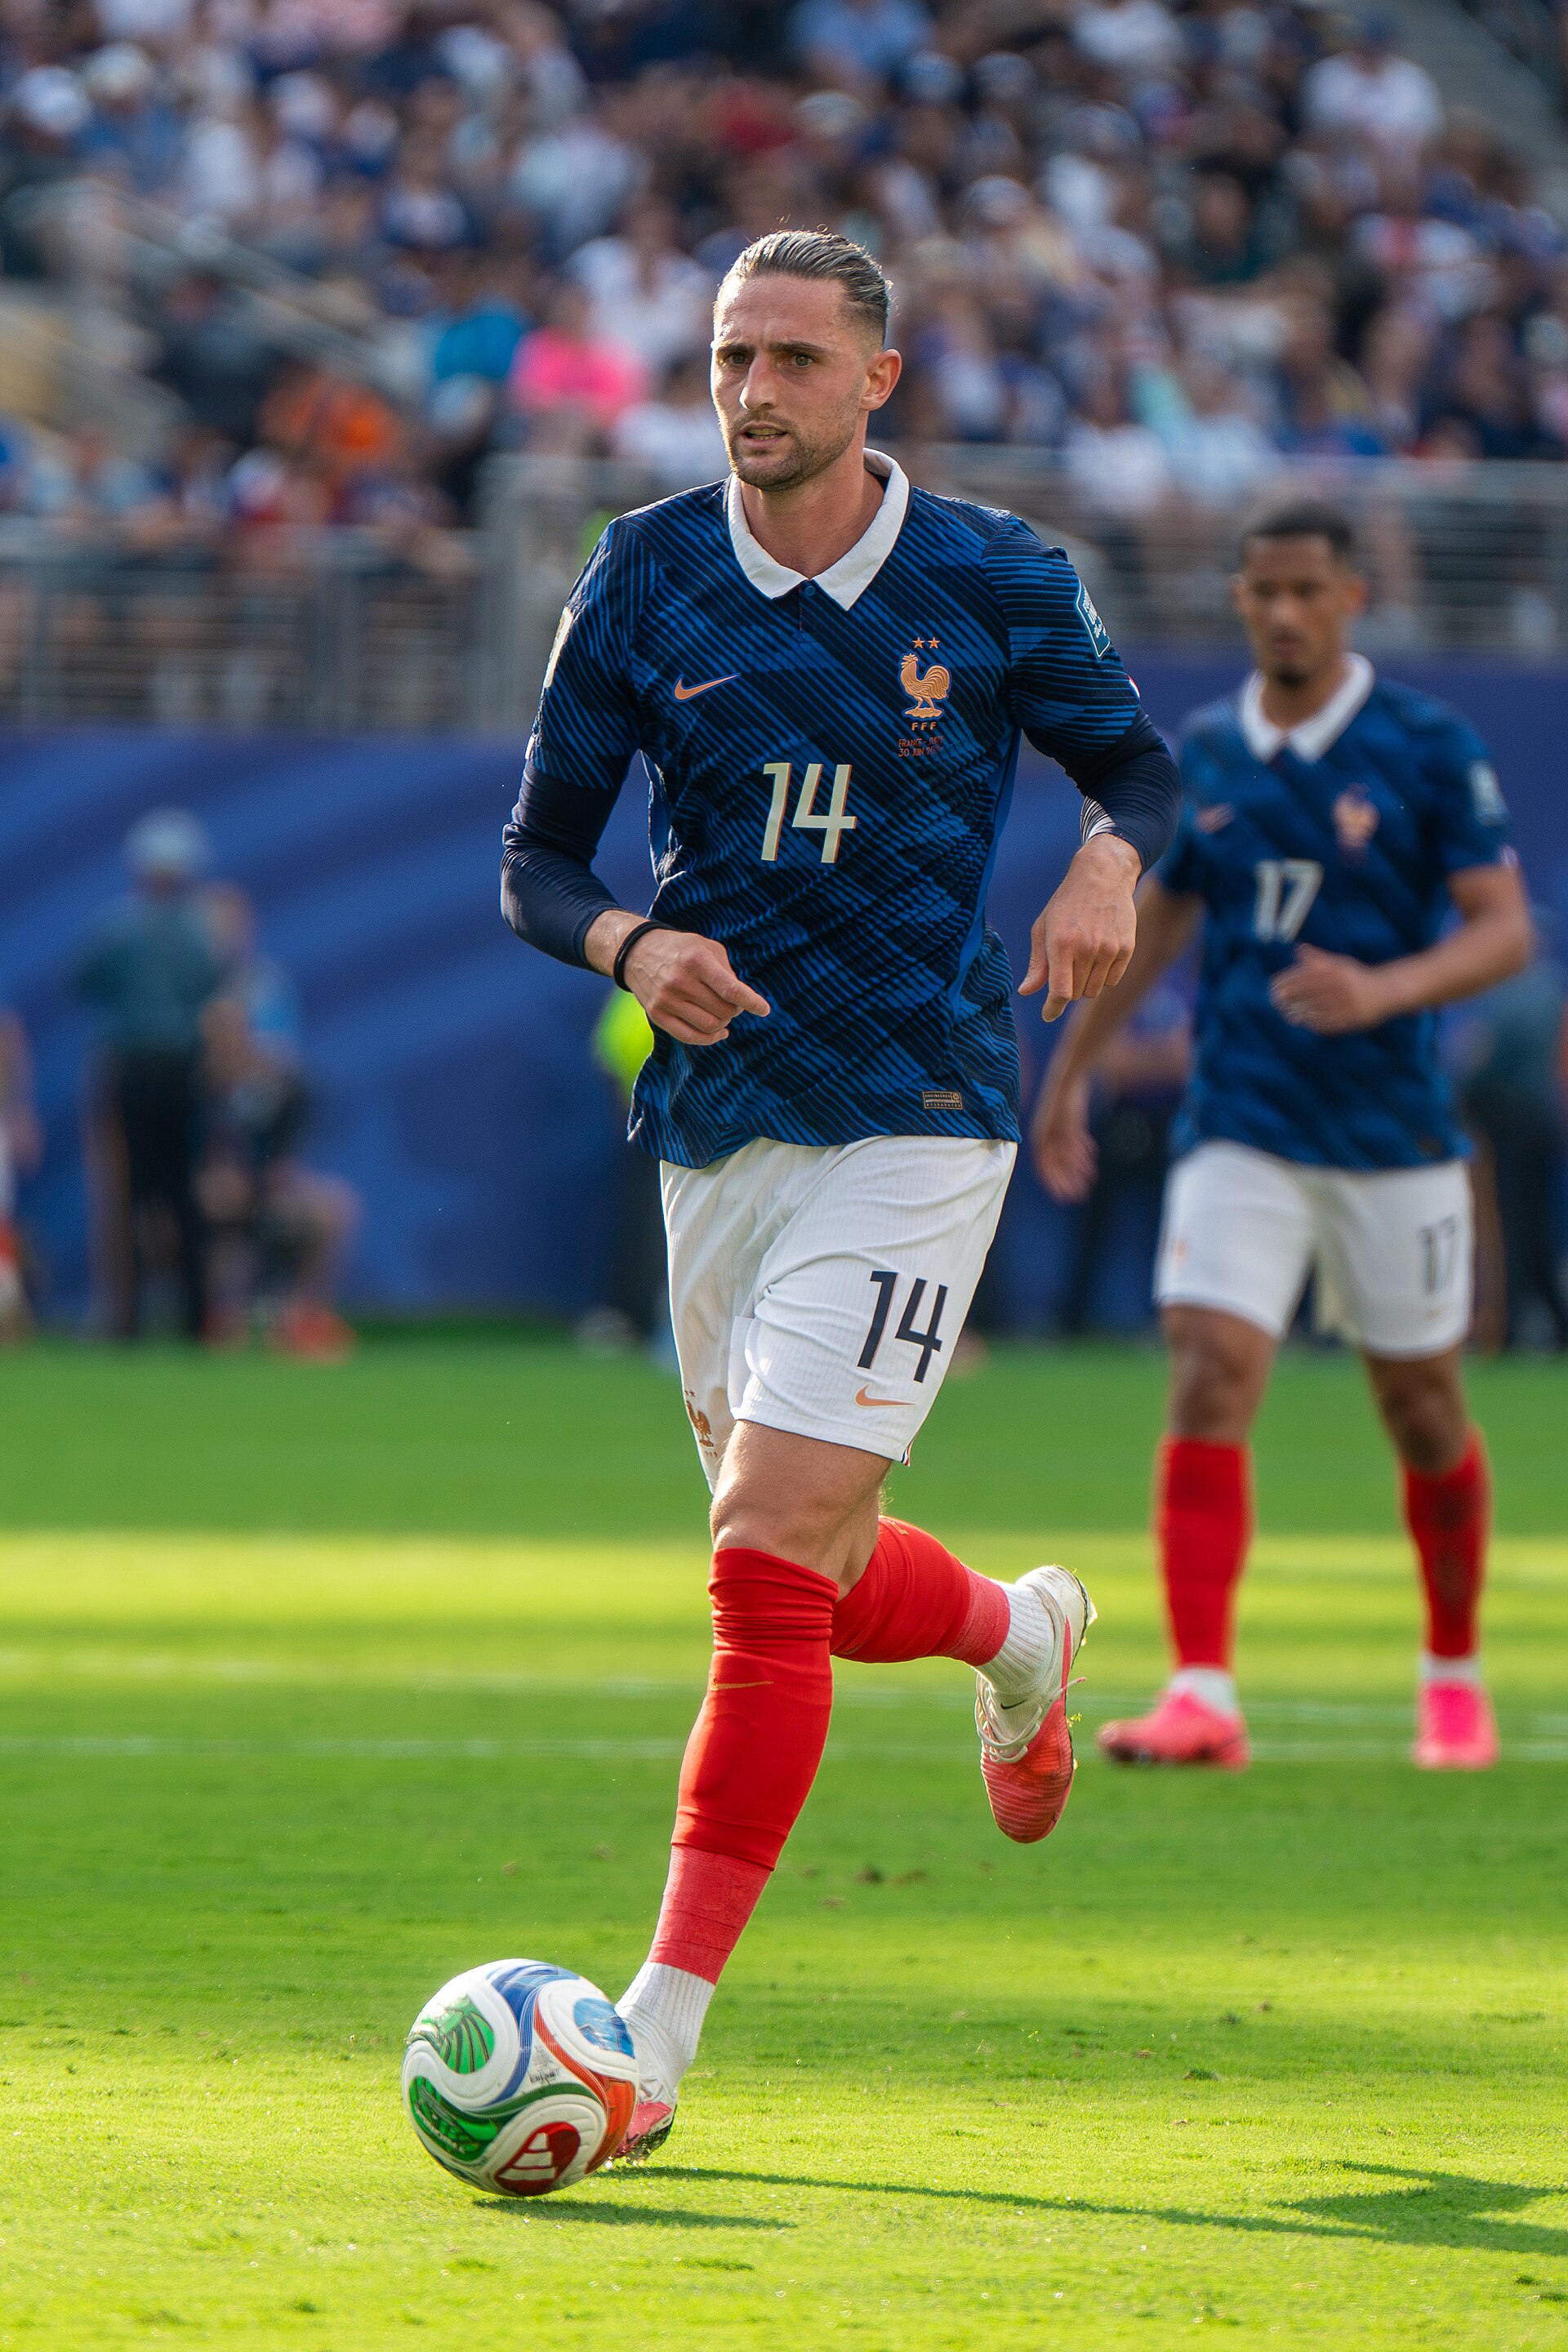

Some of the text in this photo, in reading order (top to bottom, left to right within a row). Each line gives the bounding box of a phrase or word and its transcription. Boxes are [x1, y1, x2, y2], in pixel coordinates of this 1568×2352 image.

[898, 748, 910, 757] 30
[911, 721, 937, 731] FFF
[761, 763, 858, 863] 14
[1254, 858, 1325, 943] 17
[1419, 1214, 1456, 1297] 17
[857, 1270, 948, 1383] 14
